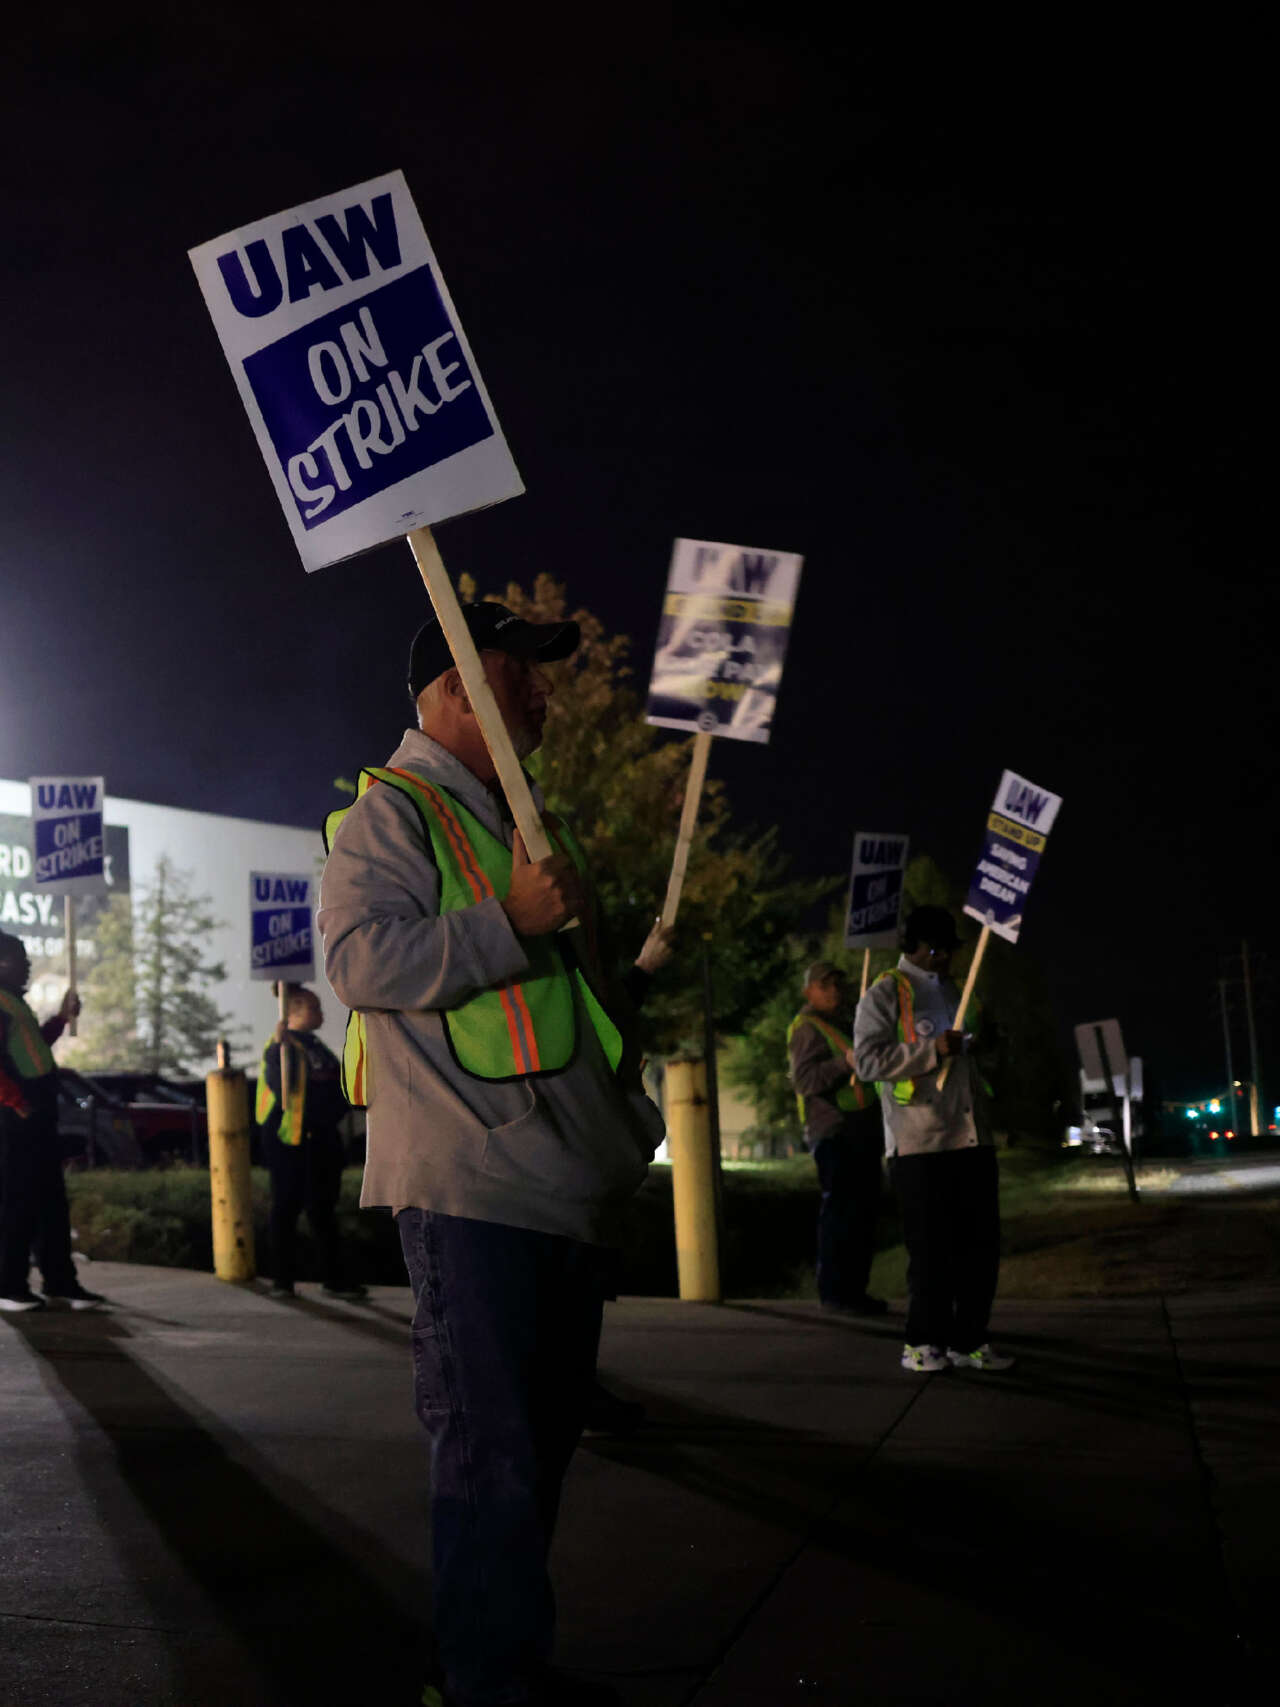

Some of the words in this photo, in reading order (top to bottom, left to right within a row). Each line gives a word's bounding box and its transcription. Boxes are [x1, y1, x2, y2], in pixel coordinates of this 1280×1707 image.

[217, 192, 402, 319] UAW
[307, 305, 389, 407] ON
[287, 330, 473, 520] STRIKE
[37, 784, 98, 810] UAW
[1006, 779, 1049, 826] UAW
[53, 818, 81, 849] ON
[861, 840, 904, 865] UAW
[36, 834, 103, 881] STRIKE
[255, 877, 309, 902] UAW
[268, 911, 293, 939] ON
[251, 927, 311, 968] STRIKE
